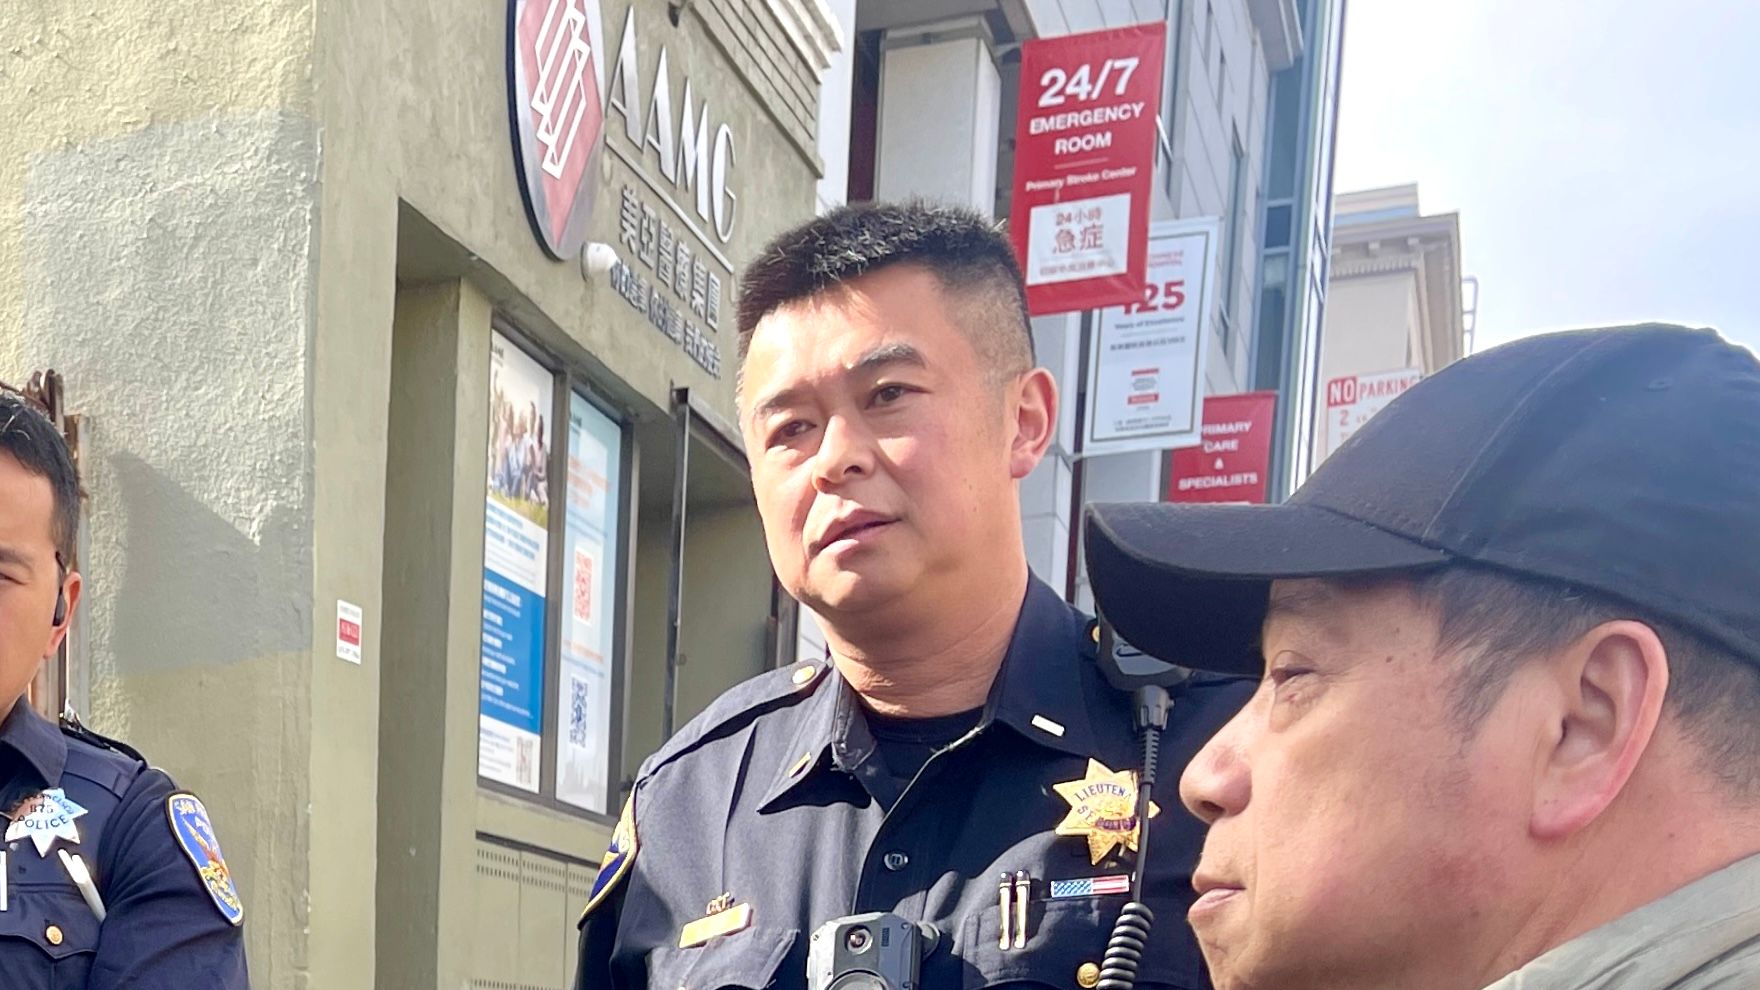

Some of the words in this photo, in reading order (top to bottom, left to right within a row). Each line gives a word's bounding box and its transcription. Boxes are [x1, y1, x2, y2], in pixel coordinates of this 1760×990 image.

[1038, 57, 1139, 108] 24/7
[605, 4, 736, 244] AAMG
[1029, 102, 1145, 135] EMERGENCY
[1054, 131, 1113, 155] ROOM
[1025, 178, 1064, 192] Primary
[1067, 172, 1099, 186] Stroke
[1102, 166, 1136, 181] Center
[1052, 223, 1103, 253] 急症
[1330, 379, 1355, 405] NO
[1340, 409, 1349, 426] 2
[1203, 439, 1239, 453] CARE
[1178, 472, 1258, 490] SPECIALISTS
